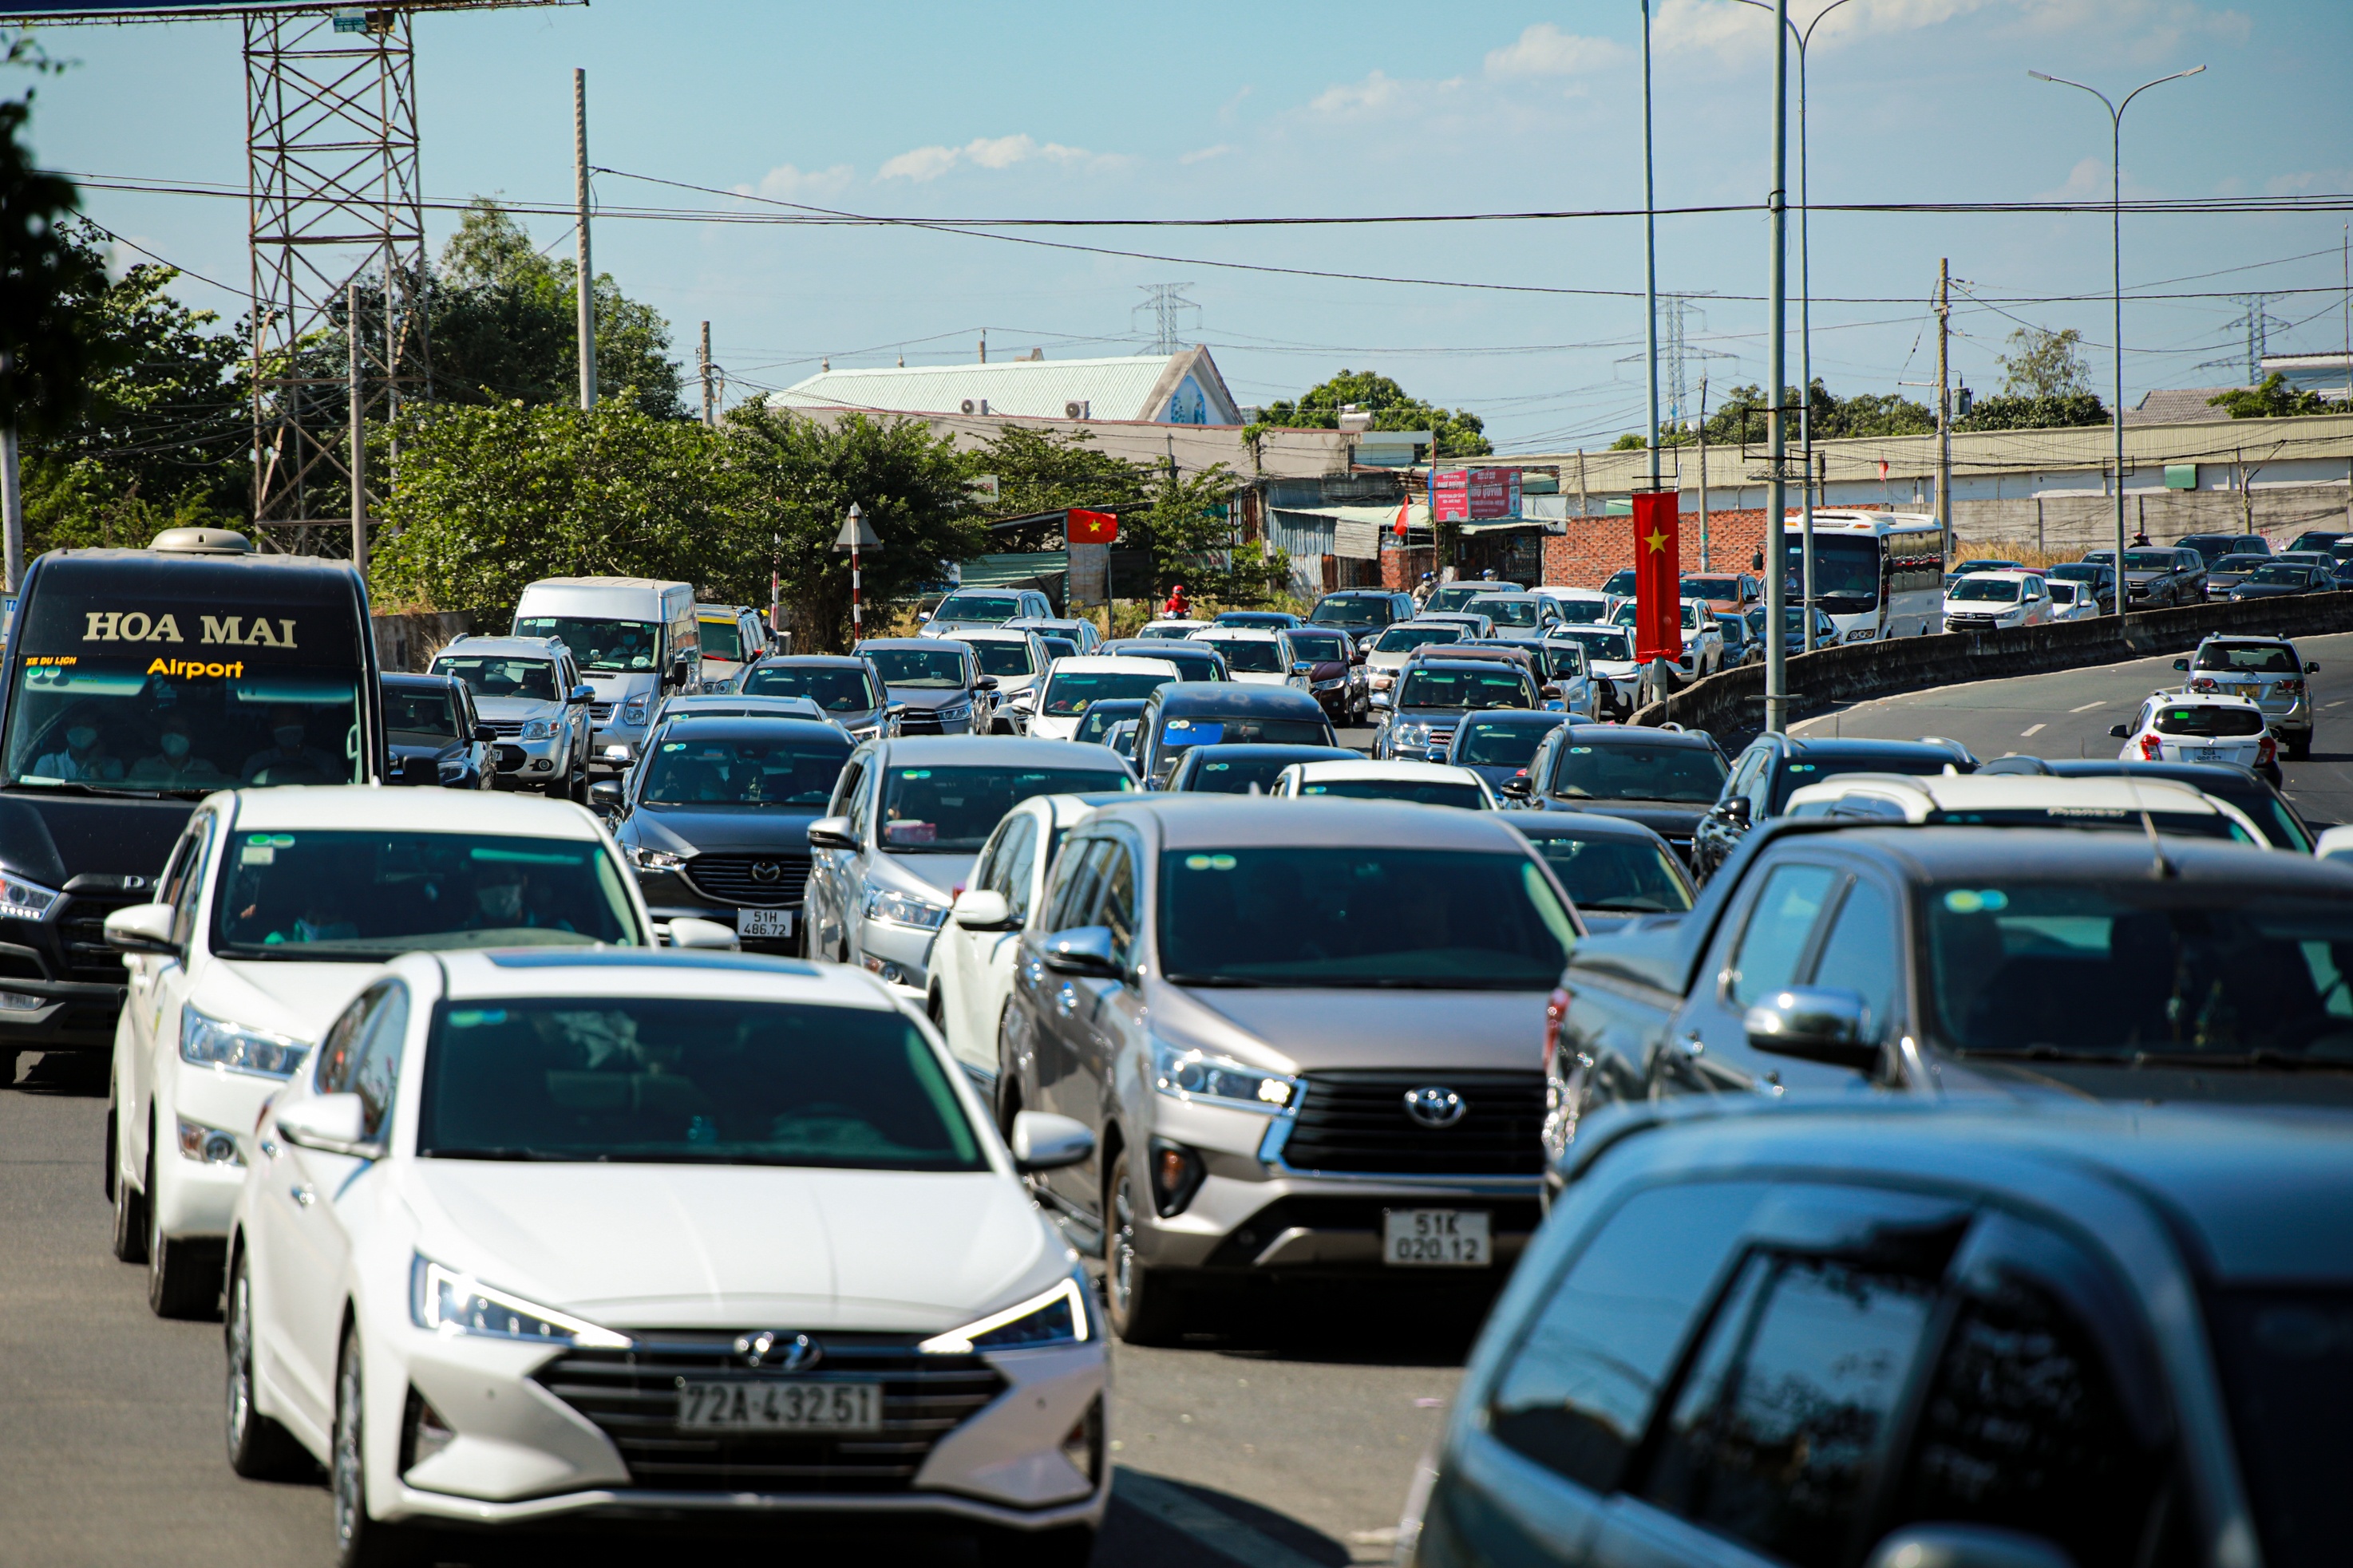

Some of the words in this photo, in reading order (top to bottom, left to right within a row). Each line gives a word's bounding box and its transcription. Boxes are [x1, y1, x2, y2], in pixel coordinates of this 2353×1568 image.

[82, 612, 184, 642] HOA
[200, 615, 299, 649] MAI
[26, 657, 38, 667] XE
[40, 657, 53, 666] DU
[54, 656, 77, 666] LỊCH
[147, 658, 243, 680] Airport
[753, 910, 777, 922] 51H
[744, 923, 785, 935] 486.72
[1416, 1214, 1460, 1235] 51K
